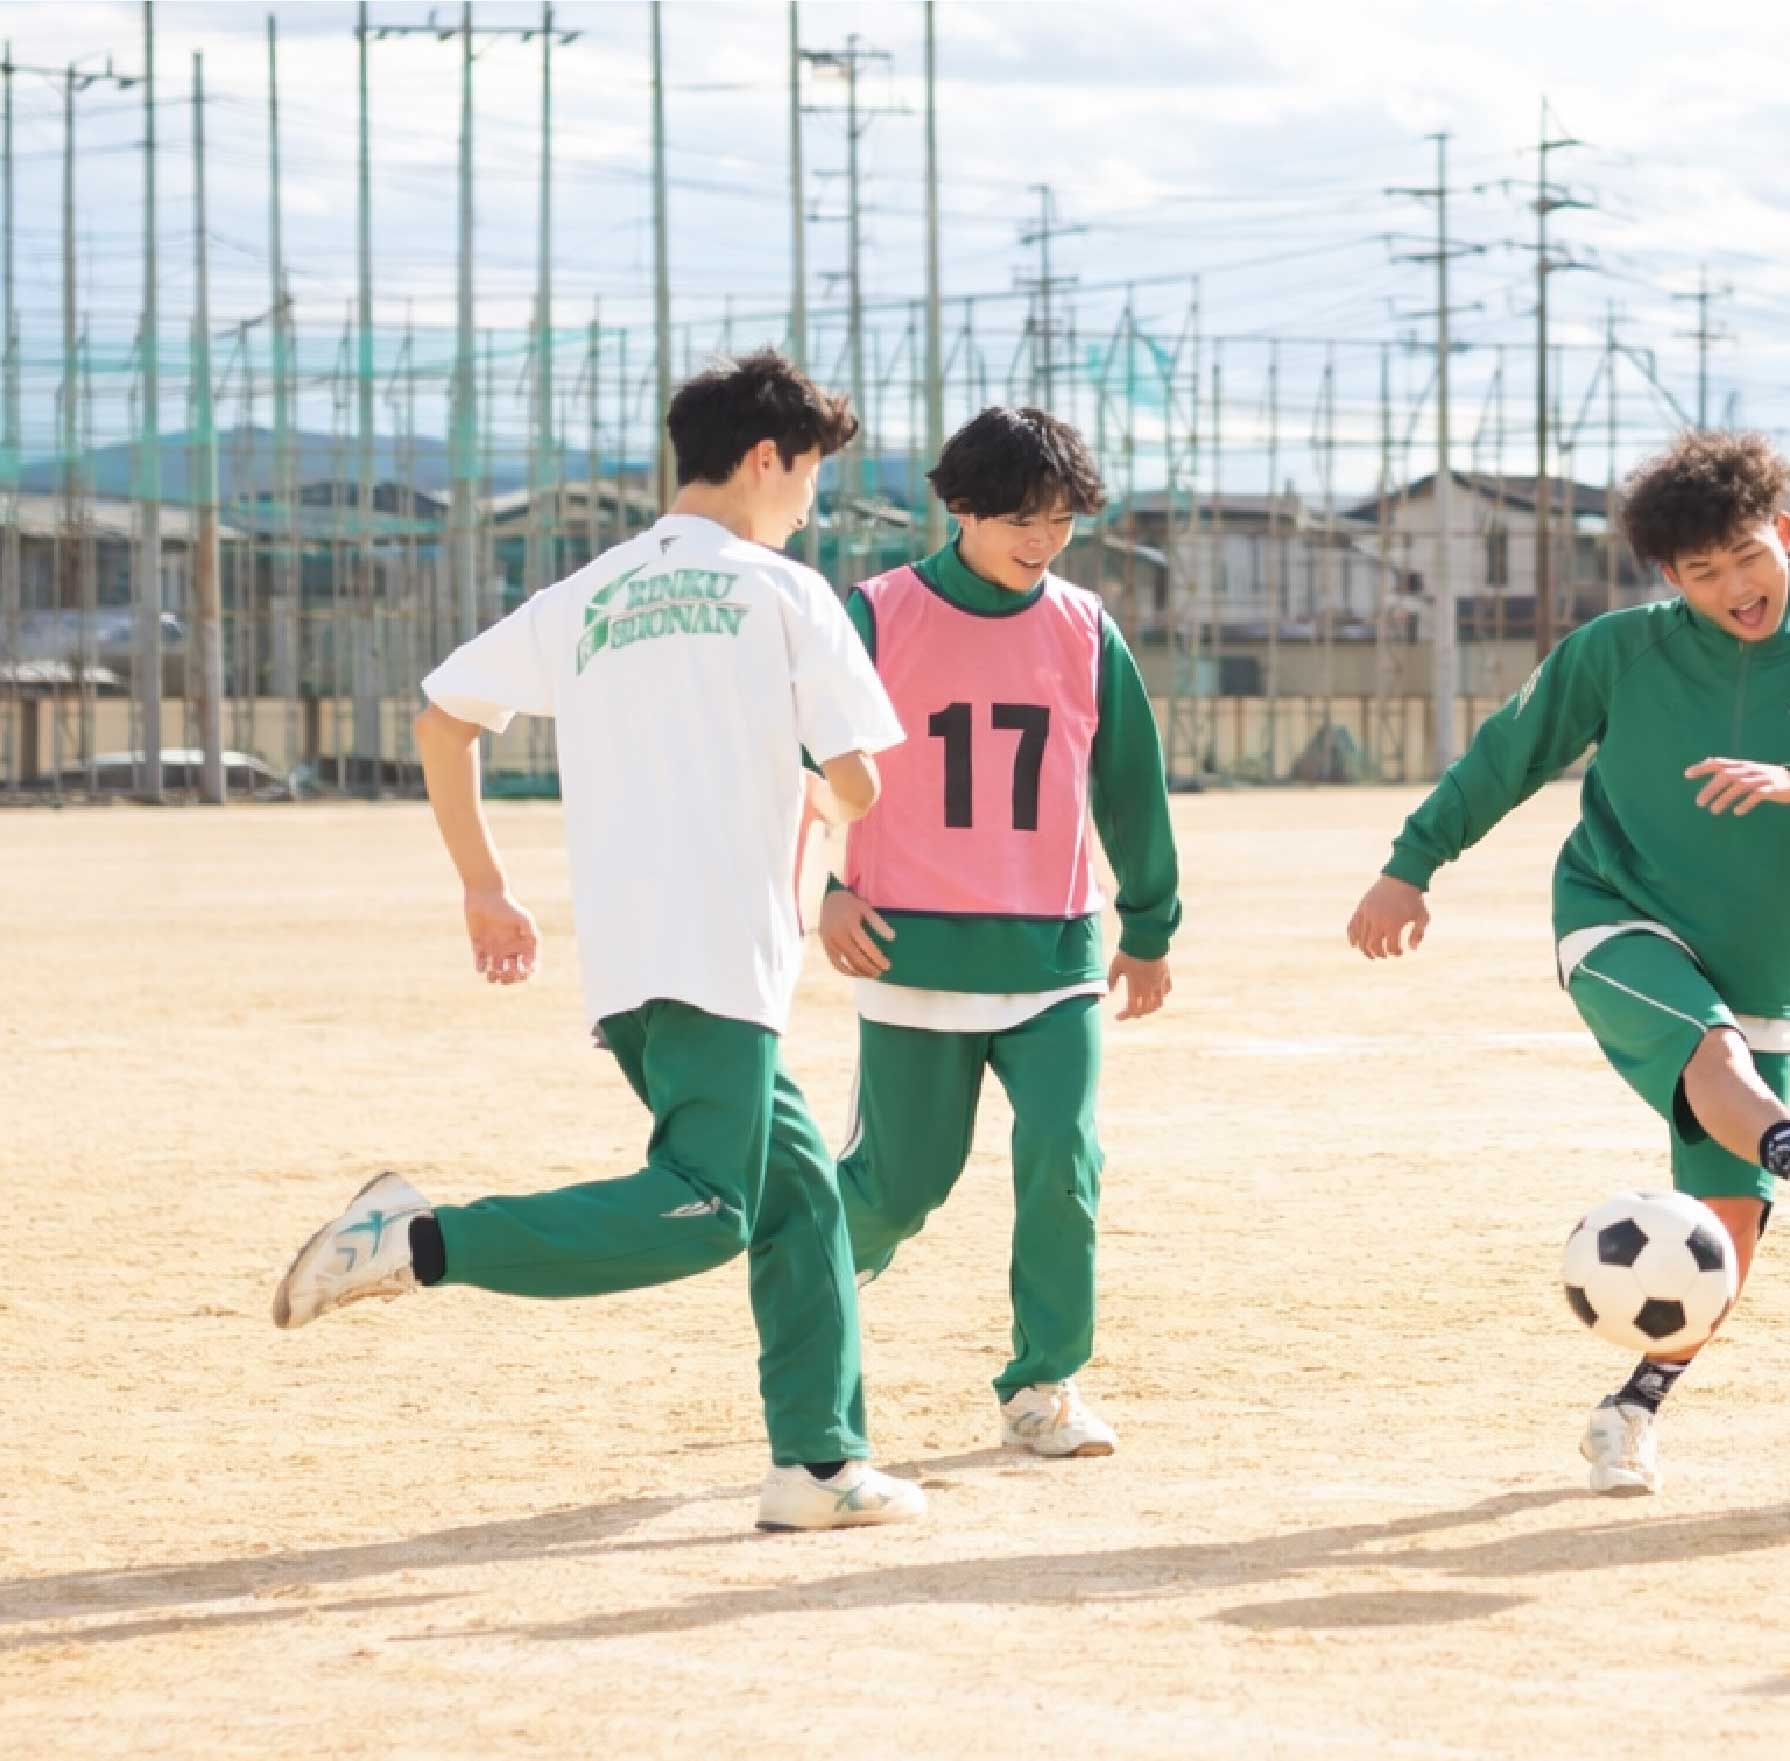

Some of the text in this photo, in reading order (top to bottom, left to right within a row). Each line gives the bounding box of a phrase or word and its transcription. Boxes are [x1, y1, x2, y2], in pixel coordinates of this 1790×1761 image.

[627, 569, 738, 609] RINKU
[610, 603, 749, 649] SHONAN
[928, 702, 1051, 831] 17
